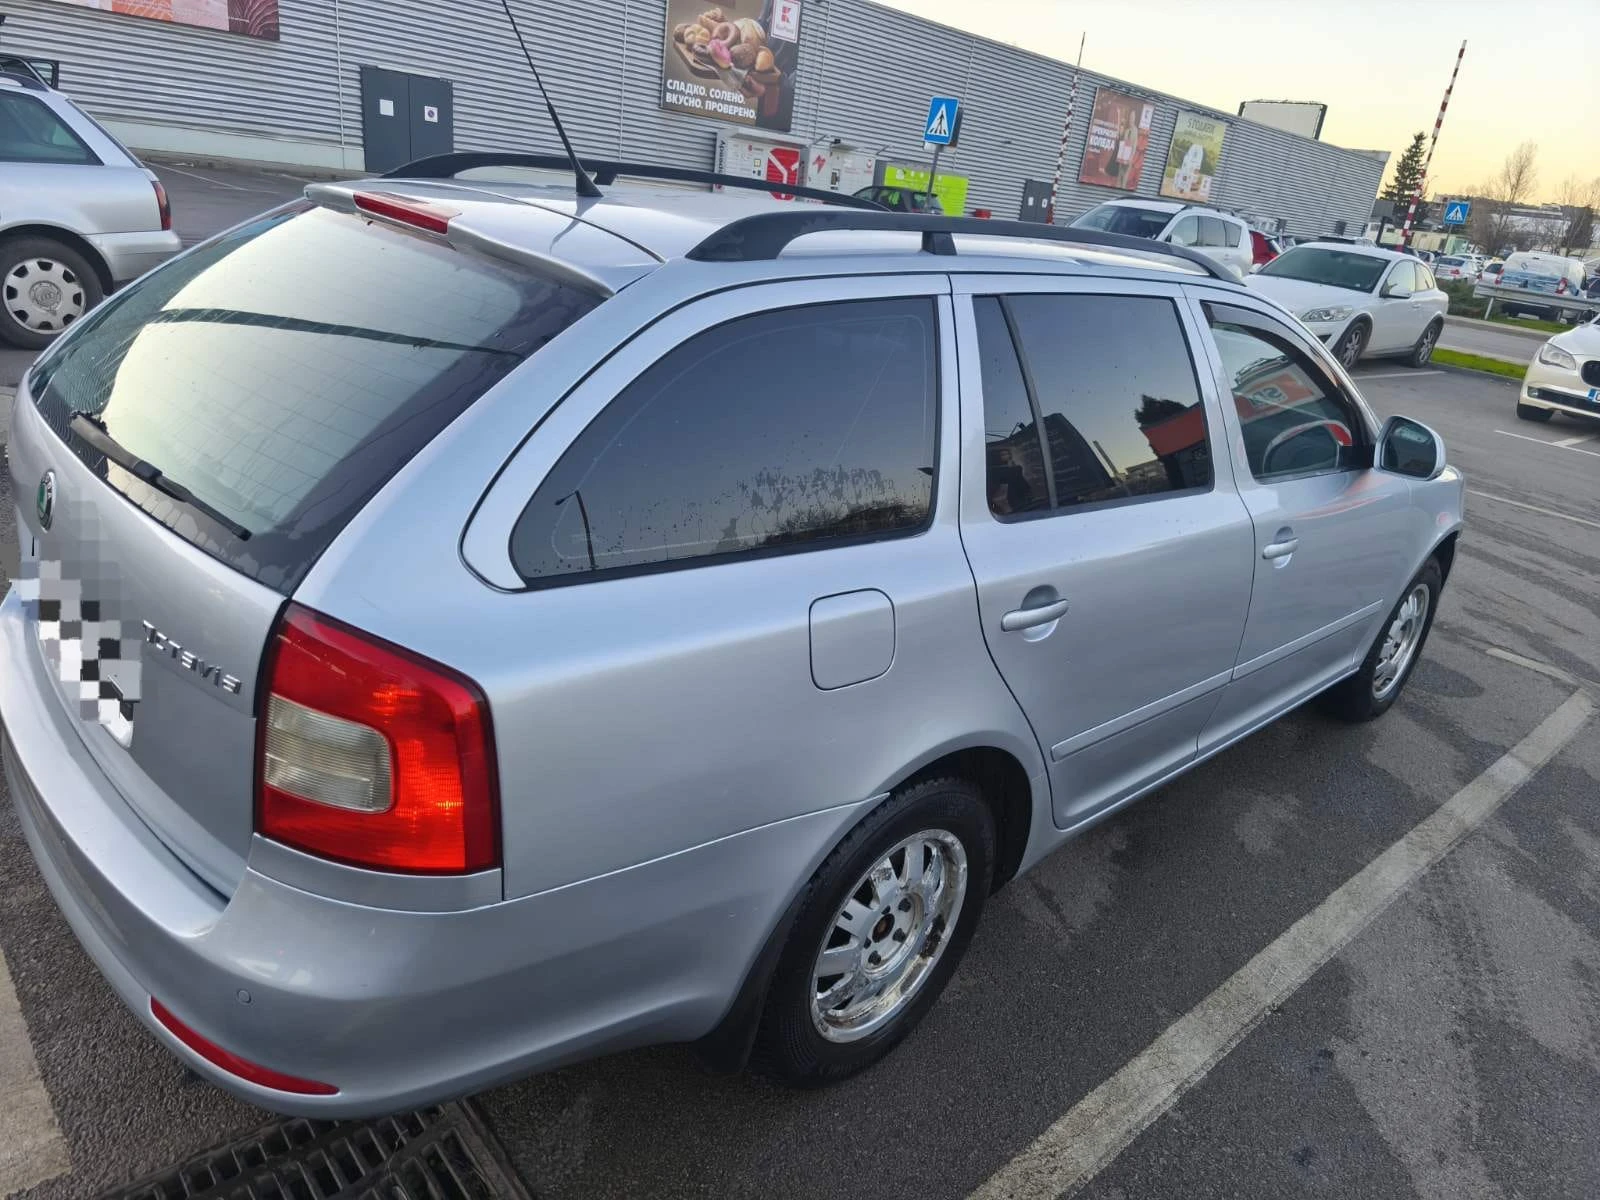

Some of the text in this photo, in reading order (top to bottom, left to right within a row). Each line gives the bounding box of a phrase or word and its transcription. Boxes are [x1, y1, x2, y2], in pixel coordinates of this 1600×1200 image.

[666, 79, 746, 104] СЛАДКО. СОЛЕНО.
[666, 92, 757, 120] ВКУСНО. ПРОВЕРЕНО.
